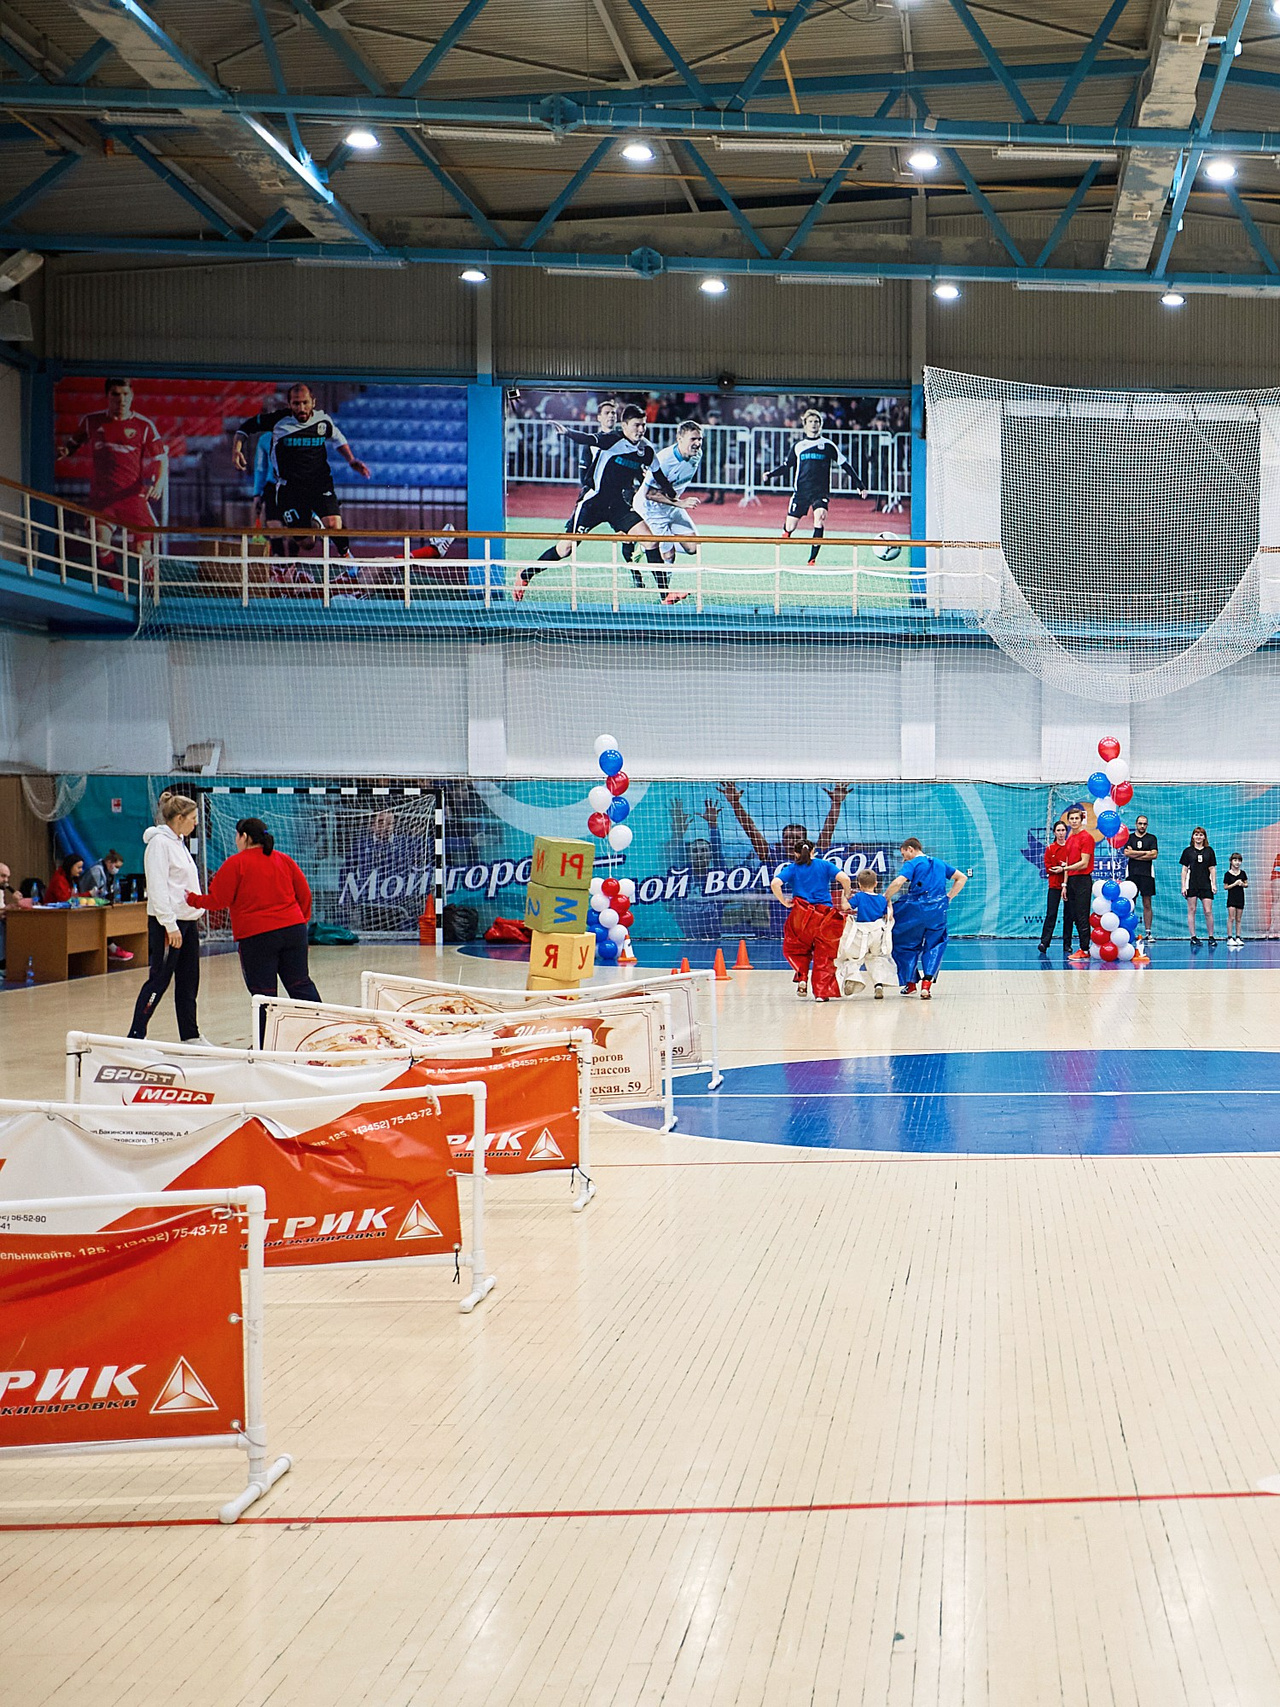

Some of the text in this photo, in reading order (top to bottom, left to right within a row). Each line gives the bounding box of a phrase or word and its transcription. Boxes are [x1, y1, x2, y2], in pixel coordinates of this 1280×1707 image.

[339, 863, 435, 904] Мой
[445, 856, 535, 898] горо
[704, 847, 888, 896] волбол
[543, 944, 559, 969] Я
[100, 1068, 171, 1083] SPORT
[141, 1088, 208, 1102] МОДА
[627, 1081, 642, 1092] 59
[391, 1108, 432, 1126] 75-43-72
[172, 1223, 228, 1240] 75-43-72
